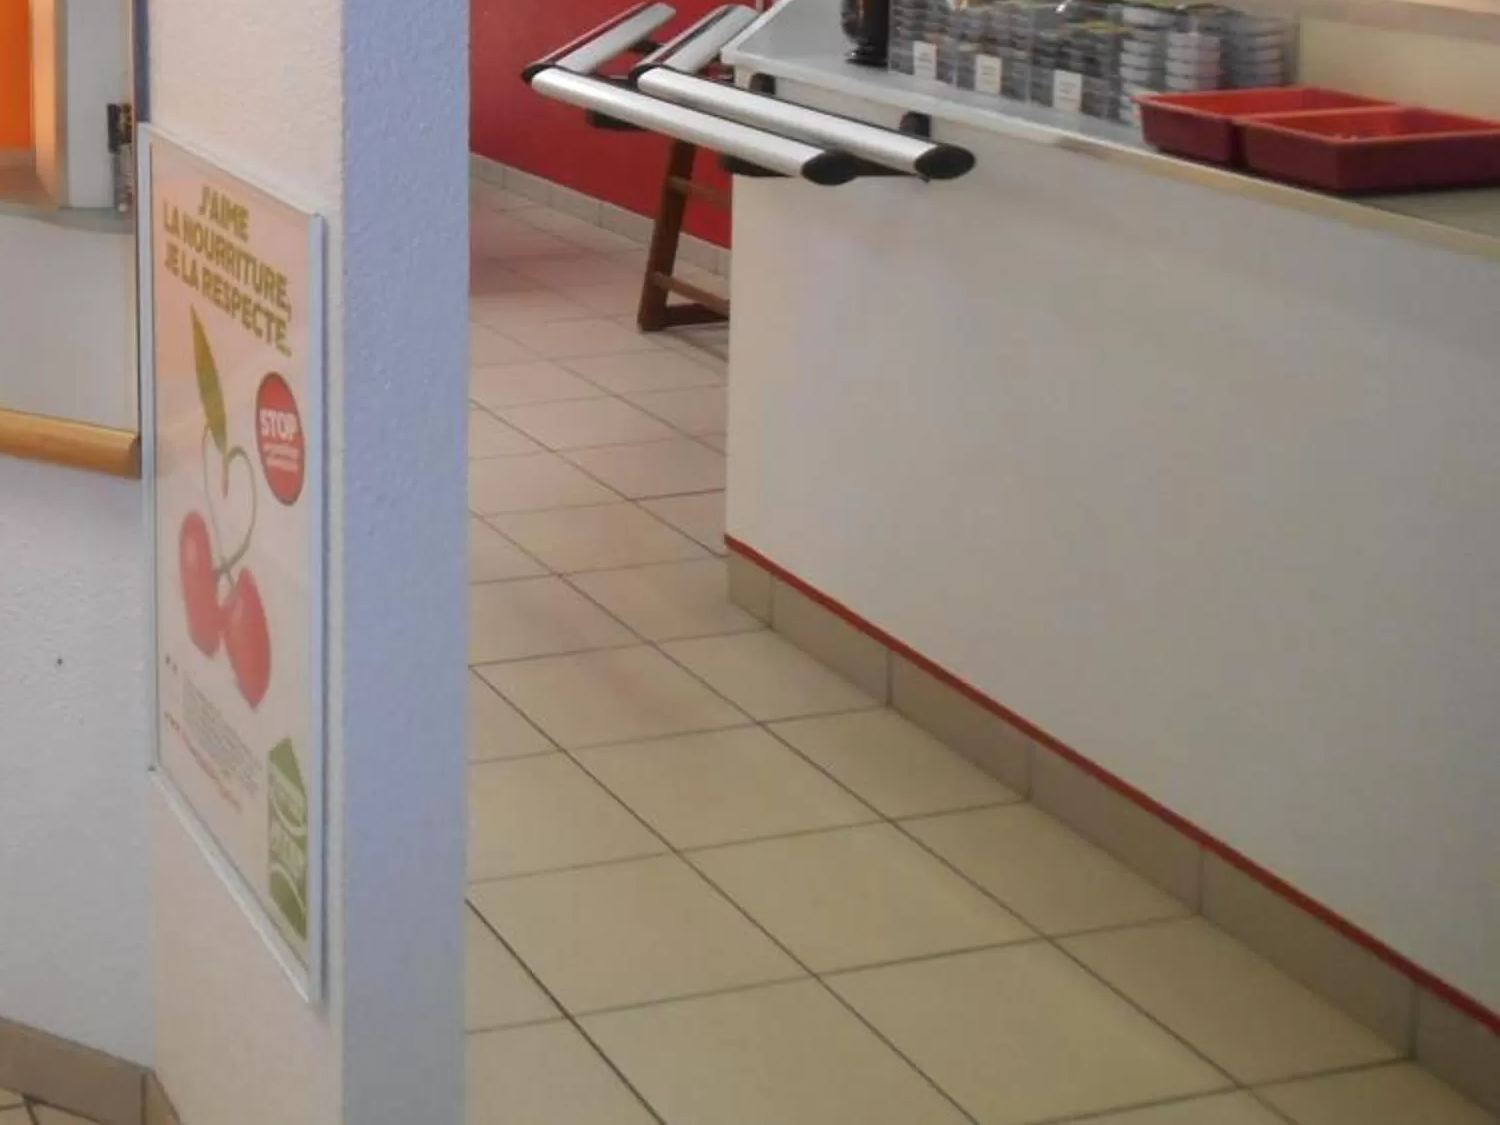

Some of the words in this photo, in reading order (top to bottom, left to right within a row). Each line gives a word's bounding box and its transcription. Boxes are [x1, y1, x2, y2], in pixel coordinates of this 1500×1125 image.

[163, 198, 181, 240] LA
[164, 239, 179, 277] JE
[181, 250, 199, 291] LA
[260, 409, 298, 442] STOP
